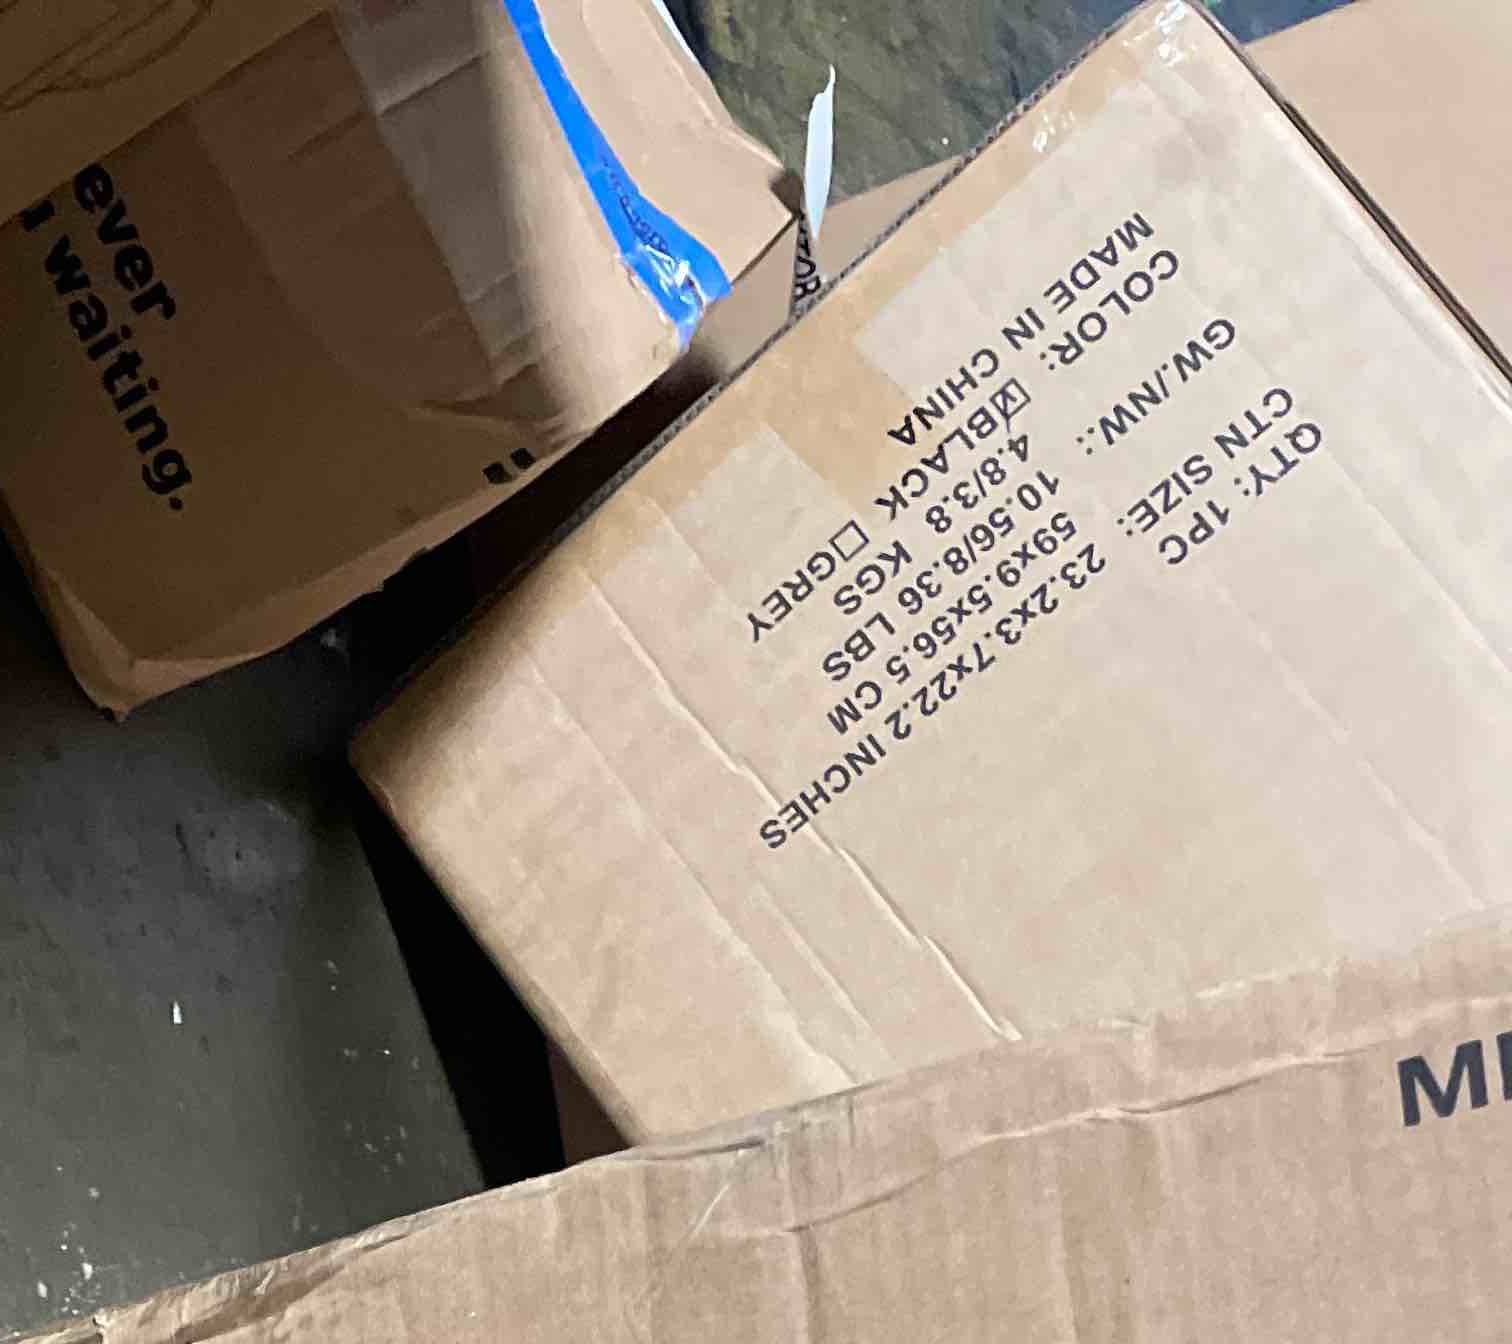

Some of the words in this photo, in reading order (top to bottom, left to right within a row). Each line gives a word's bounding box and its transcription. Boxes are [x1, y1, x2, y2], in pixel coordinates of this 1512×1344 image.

[1040, 249, 1180, 372] COLOR:
[1044, 211, 1156, 314] MADE
[44, 233, 193, 511] waiting.
[1000, 306, 1047, 351] IN
[887, 348, 1001, 447] CHINA
[1213, 387, 1295, 459] CTN
[873, 408, 998, 521] BLACK
[924, 432, 1030, 534] 4.8/3.8
[1117, 454, 1214, 538] SIZE:
[1234, 421, 1323, 496] QTY:
[833, 540, 913, 617] KGS
[896, 470, 1061, 617] 10.56/8.36
[1158, 500, 1232, 567] 1PC
[745, 550, 839, 642] GREY
[884, 542, 1107, 741] 23.2x3.7x22.2
[886, 510, 1077, 684] 59x9.5x56.5
[822, 612, 896, 682] LBS
[826, 679, 884, 736] CM
[759, 732, 888, 850] INCHES
